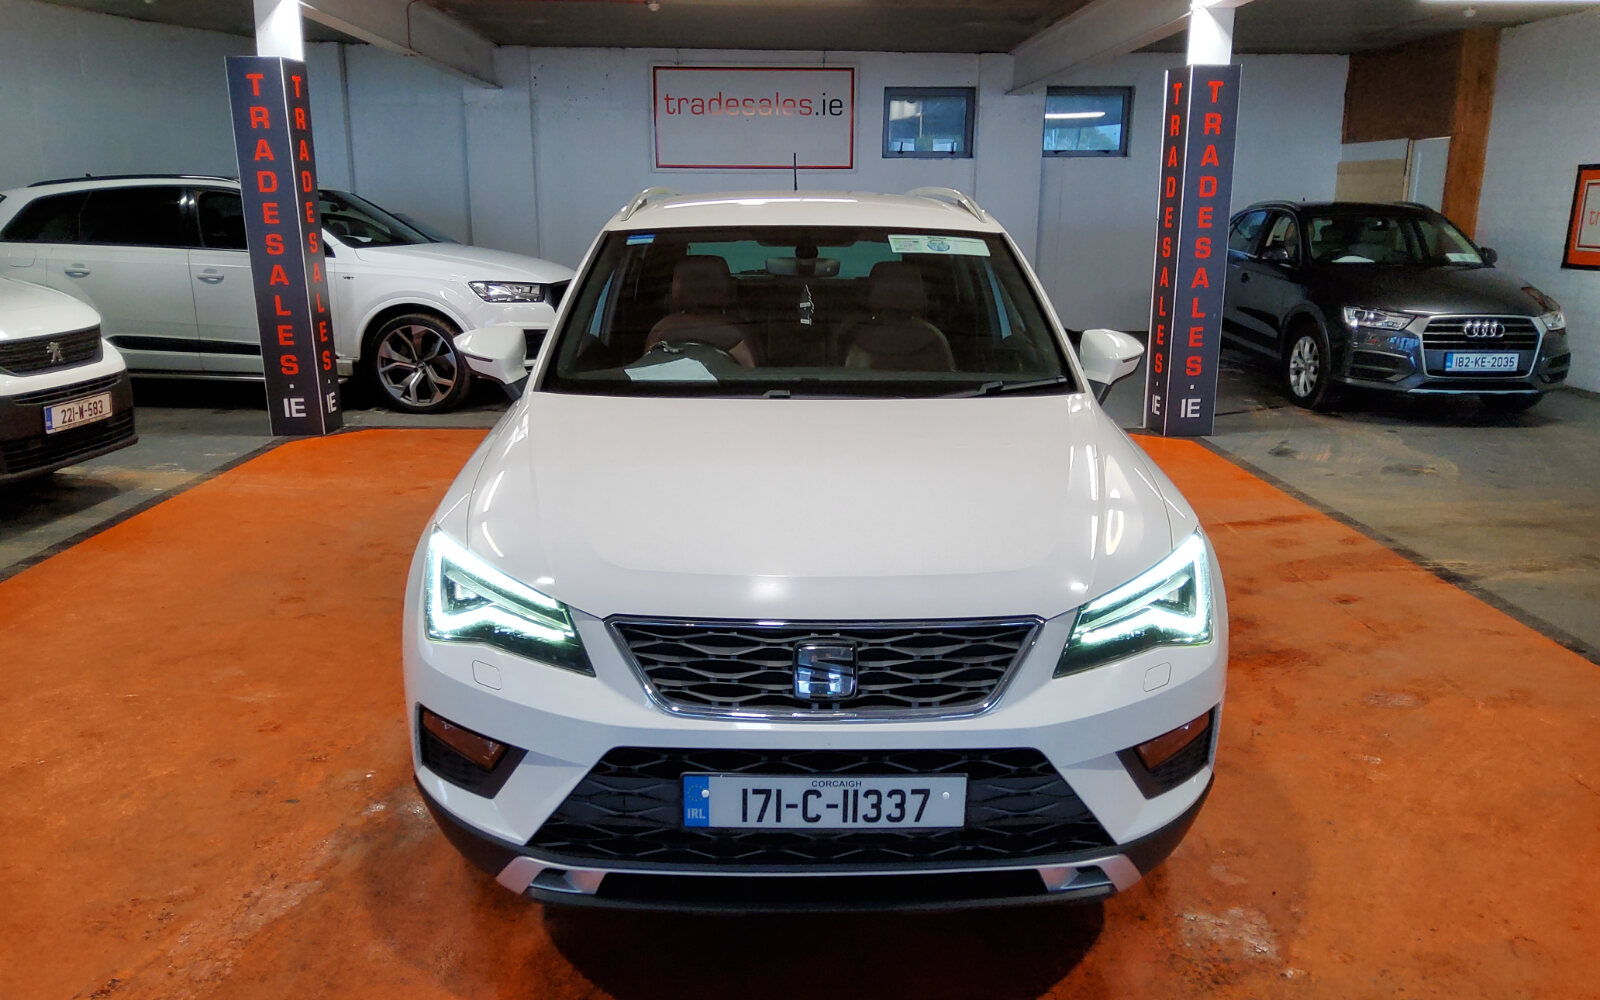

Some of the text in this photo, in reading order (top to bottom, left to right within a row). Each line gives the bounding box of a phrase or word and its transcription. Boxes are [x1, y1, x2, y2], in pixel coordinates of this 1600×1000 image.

[664, 91, 843, 116] tradesales.ie
[1455, 356, 1515, 368] 182-KE-2035
[61, 400, 104, 425] 221-W-583
[811, 780, 862, 788] CORCAIGH
[687, 808, 706, 820] IRL
[741, 788, 931, 823] 171-C-11337
